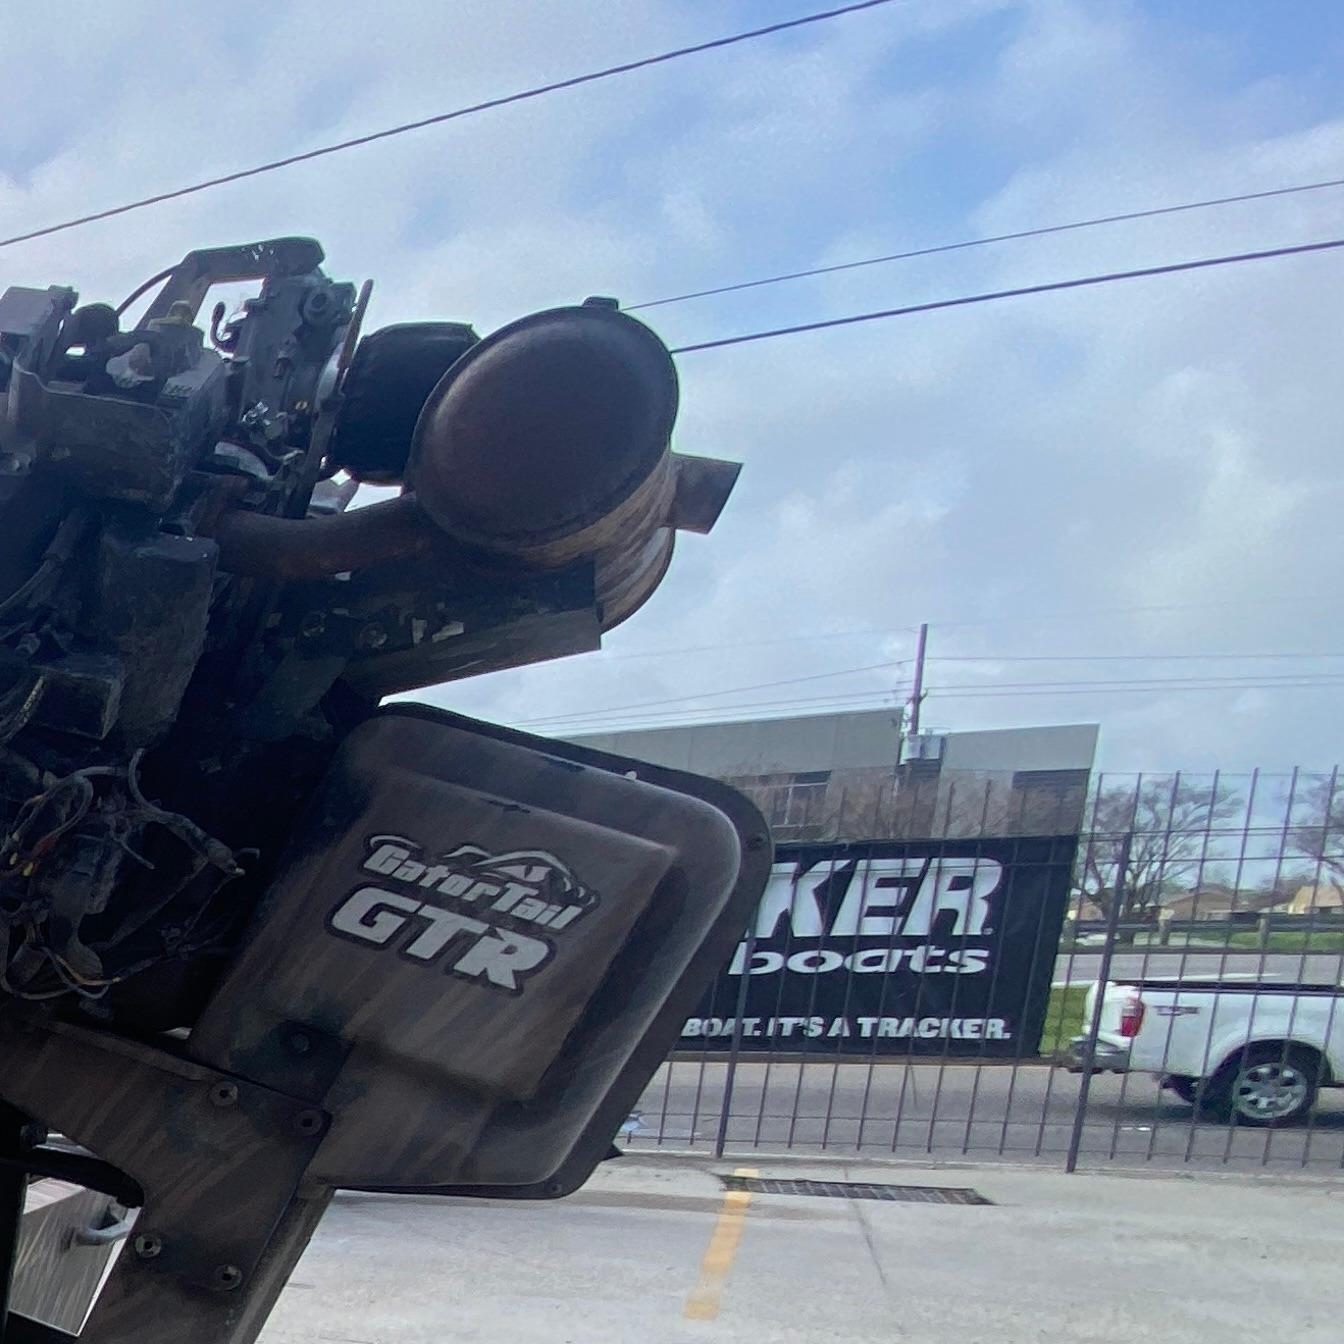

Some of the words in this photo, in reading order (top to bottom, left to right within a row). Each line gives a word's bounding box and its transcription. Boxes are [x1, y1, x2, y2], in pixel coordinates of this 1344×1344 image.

[362, 844, 583, 929] GatorTail
[748, 857, 1003, 938] KER
[330, 886, 550, 990] GTR
[728, 944, 990, 975] boats
[680, 1018, 762, 1037] BOAT.
[827, 1017, 850, 1037] A
[857, 1017, 1012, 1039] TRACKER.
